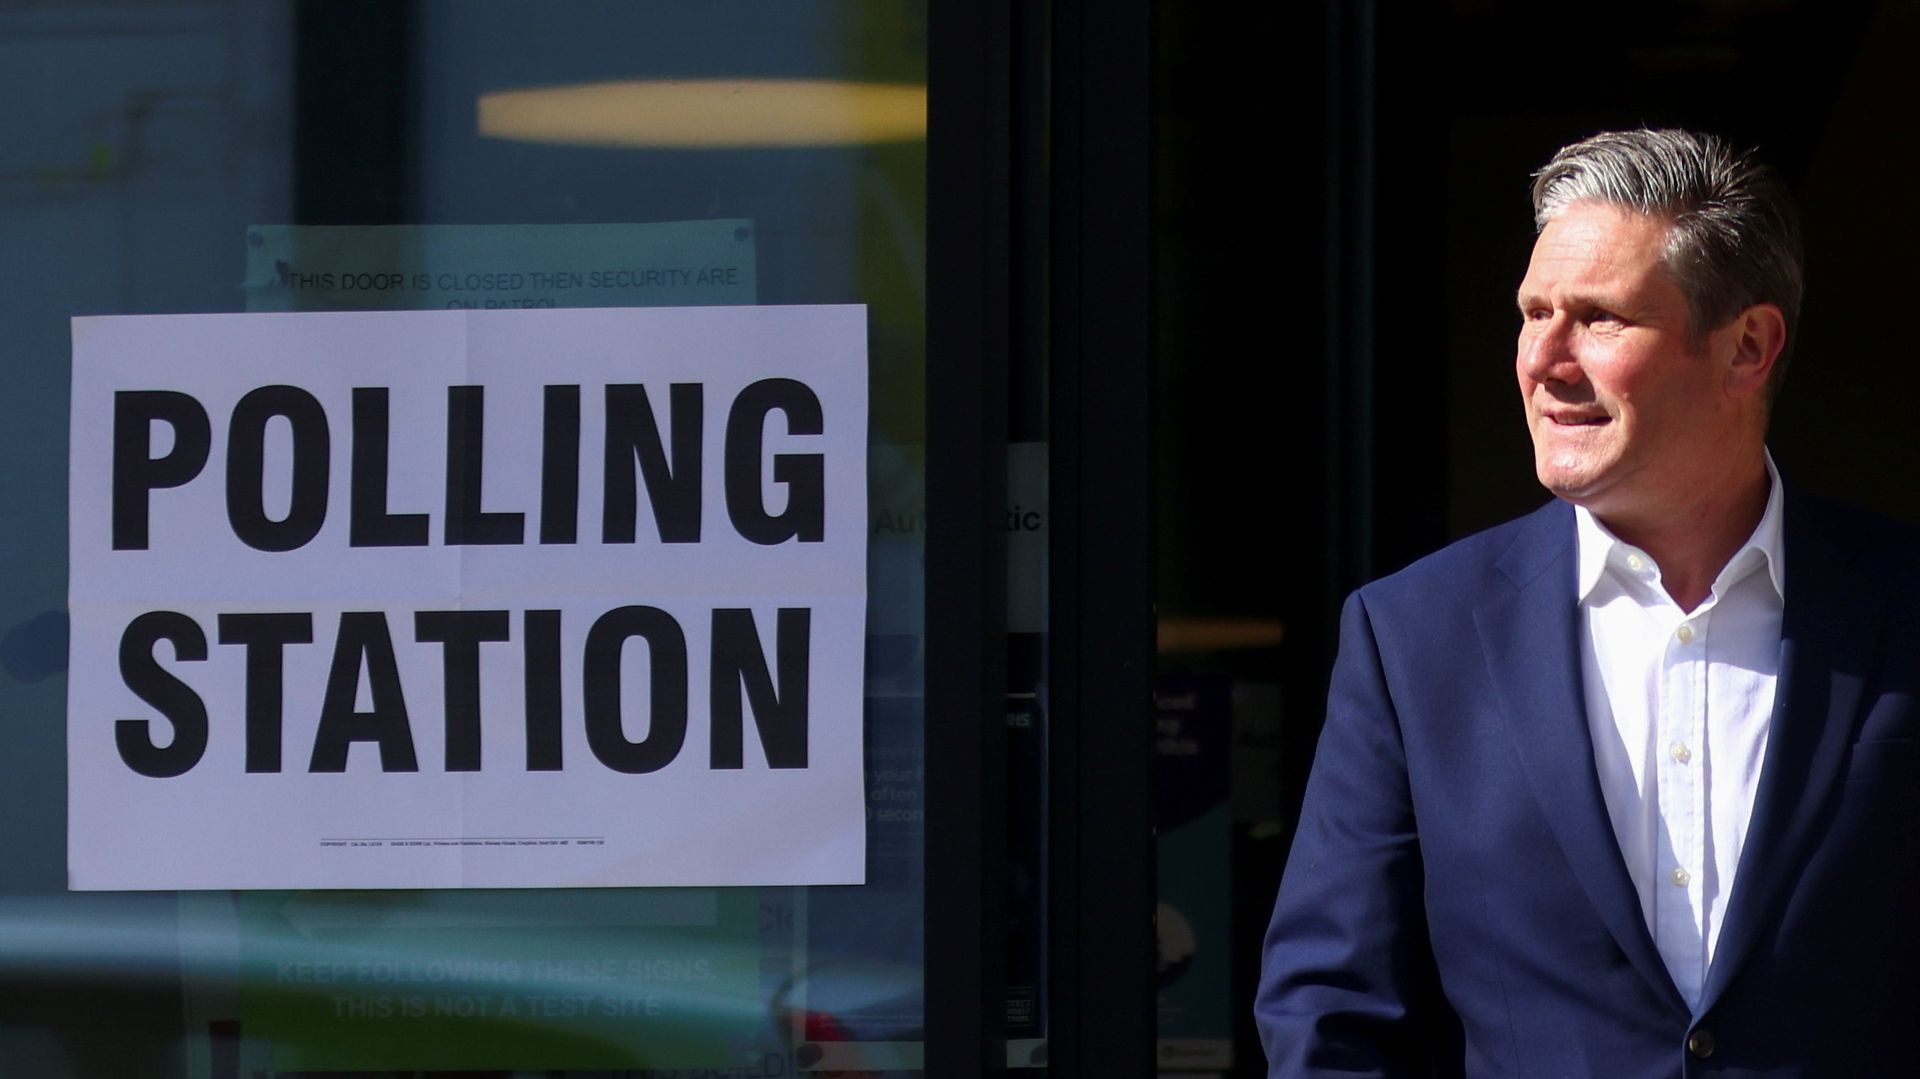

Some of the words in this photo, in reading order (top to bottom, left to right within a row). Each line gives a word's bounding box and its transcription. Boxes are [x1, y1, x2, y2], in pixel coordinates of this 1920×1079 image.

[290, 273, 336, 291] THIS
[342, 272, 406, 291] DOOR
[412, 273, 432, 291] IS
[438, 272, 524, 291] CLOSED
[530, 272, 583, 289] THEN
[590, 268, 694, 289] SECURITY
[696, 267, 740, 286] ARE
[113, 378, 824, 552] POLLING
[115, 605, 811, 778] STATION
[1007, 713, 1030, 726] HS
[871, 785, 917, 801] often
[276, 961, 345, 983] KEEP
[356, 960, 521, 982] FOLLOWING
[528, 960, 617, 981] THESE
[333, 996, 393, 1019] THIS
[402, 996, 427, 1018] IS
[433, 995, 492, 1018] NOT
[499, 996, 519, 1017] A
[528, 995, 595, 1017] TEST
[601, 994, 662, 1017] SITE
